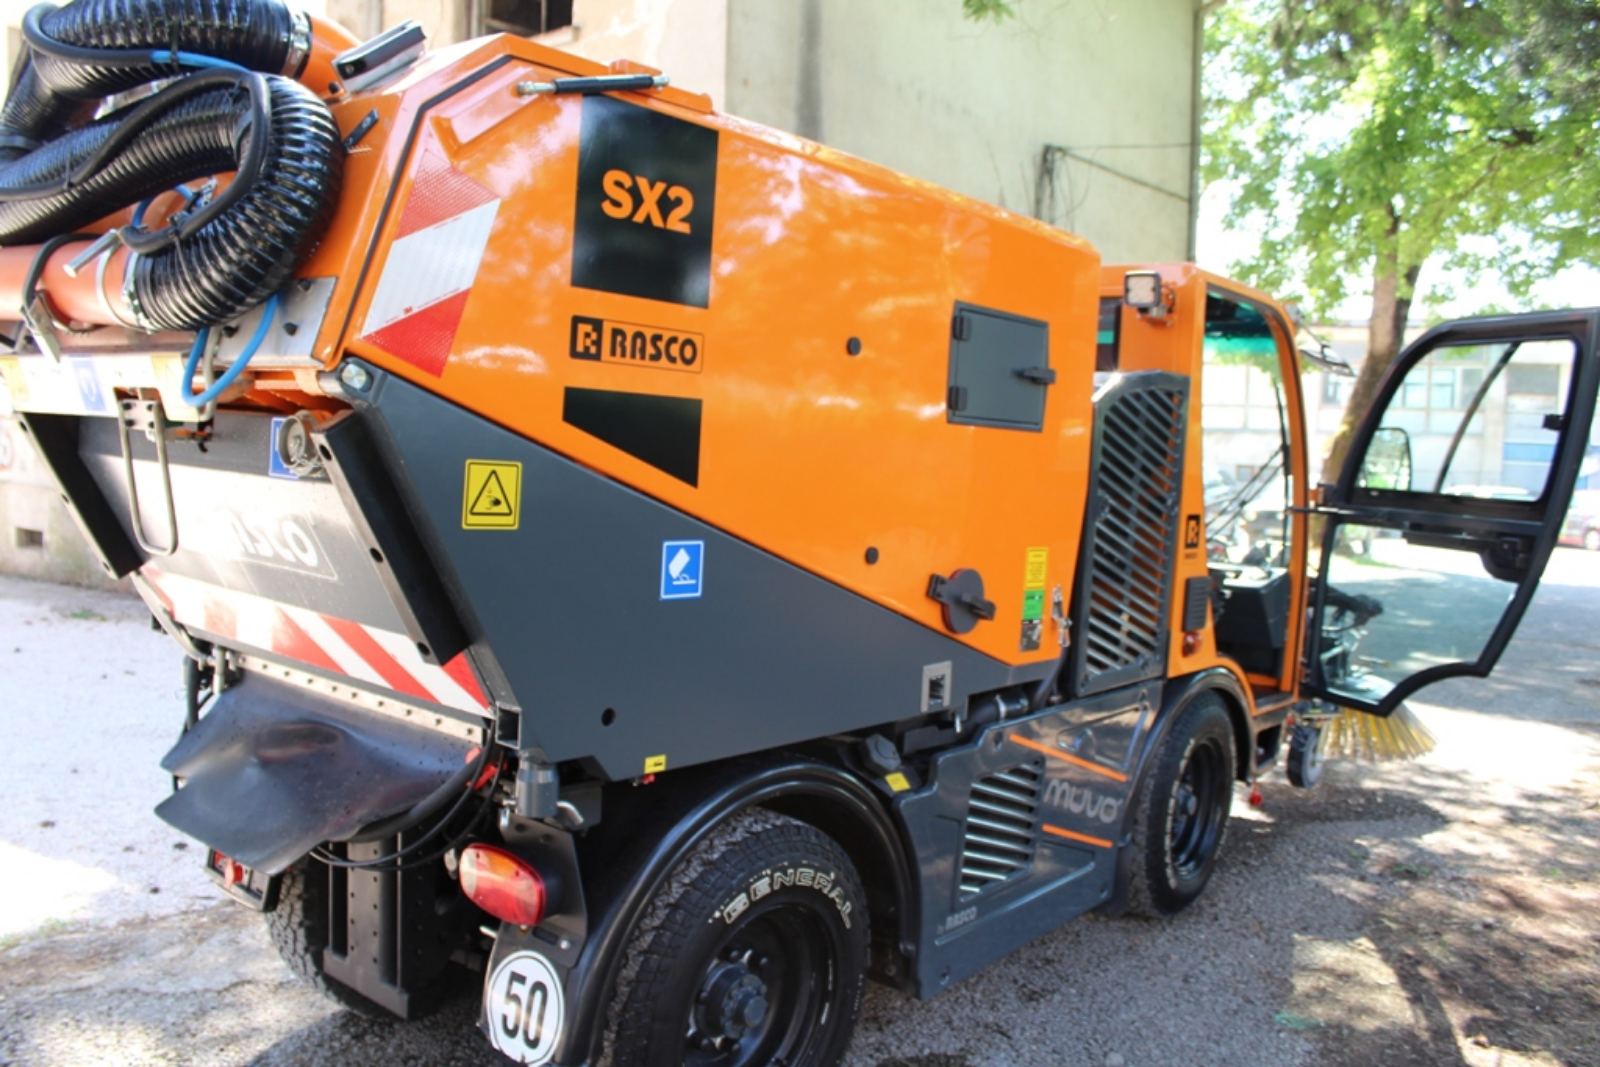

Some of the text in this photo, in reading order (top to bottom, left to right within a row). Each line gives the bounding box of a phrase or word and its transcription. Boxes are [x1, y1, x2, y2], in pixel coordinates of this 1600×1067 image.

[600, 168, 695, 235] SX2
[609, 327, 699, 367] RASCO
[501, 970, 548, 1049] 50
